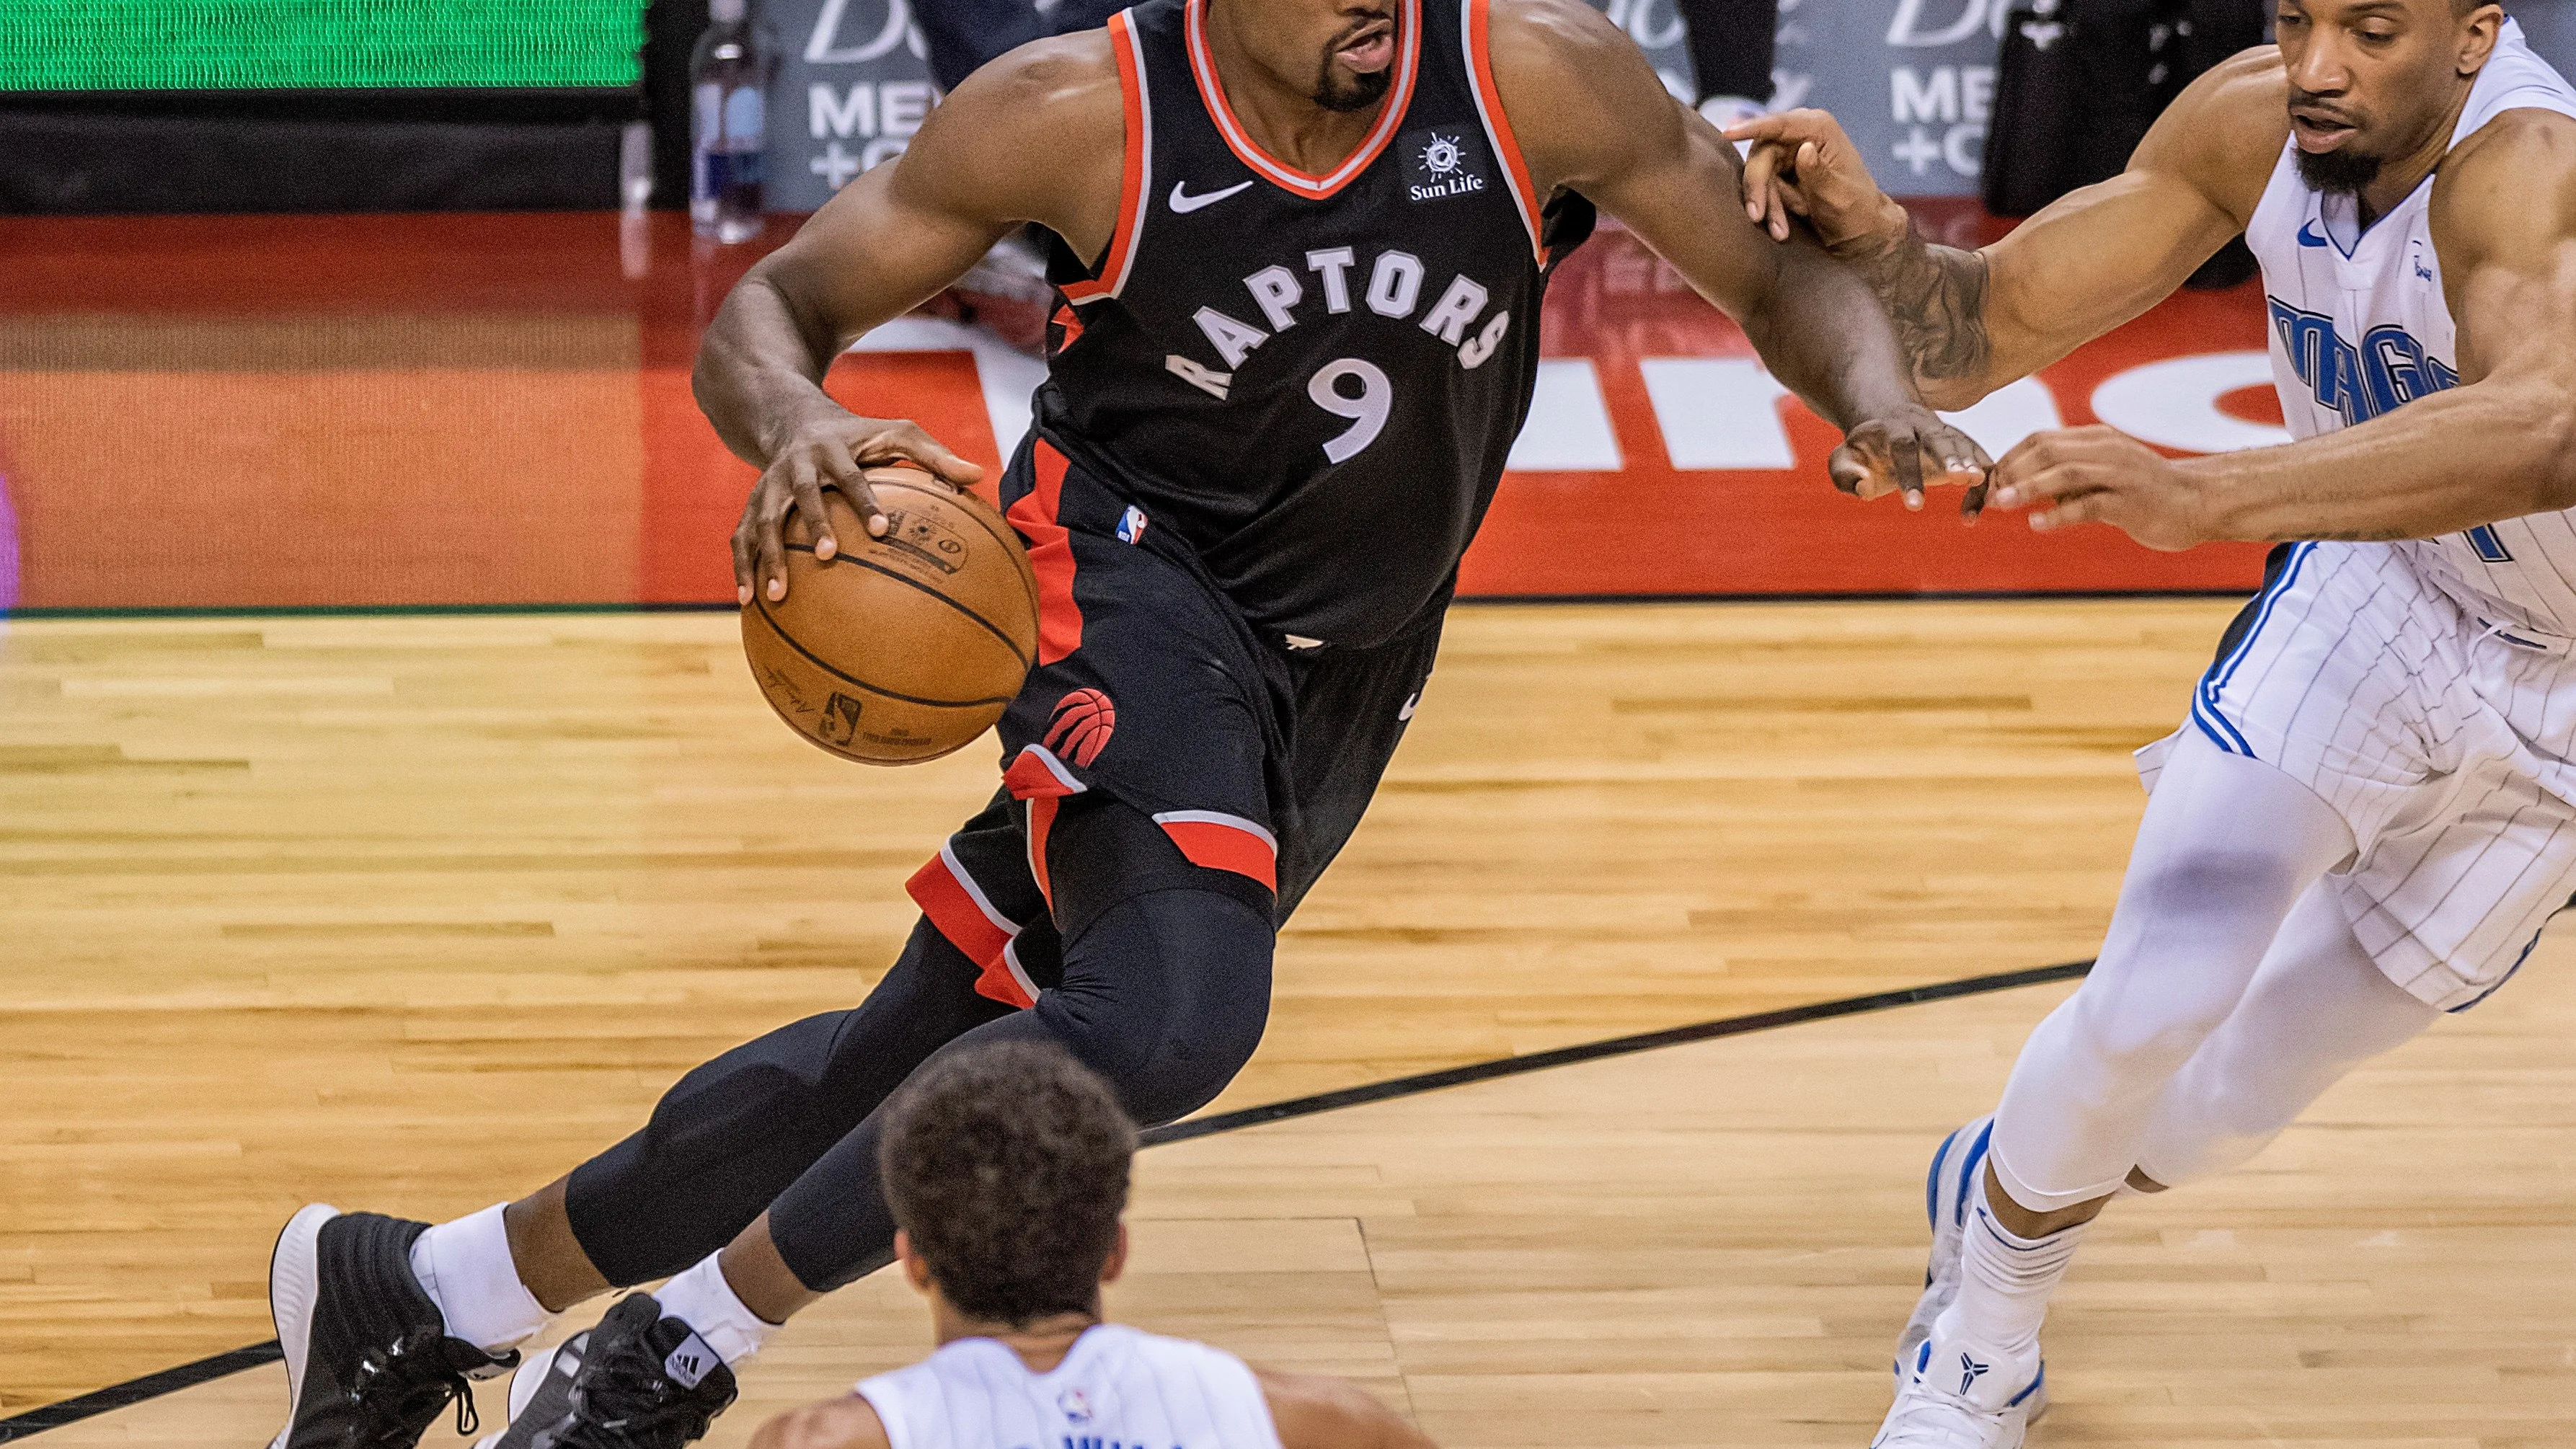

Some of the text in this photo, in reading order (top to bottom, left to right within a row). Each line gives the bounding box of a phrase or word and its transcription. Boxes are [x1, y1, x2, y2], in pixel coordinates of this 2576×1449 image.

[807, 81, 943, 139] ME
[1890, 66, 1996, 124] ME
[1410, 174, 1483, 200] Sun Life
[1165, 246, 1510, 401] RAPTORS
[1306, 358, 1392, 464] 9
